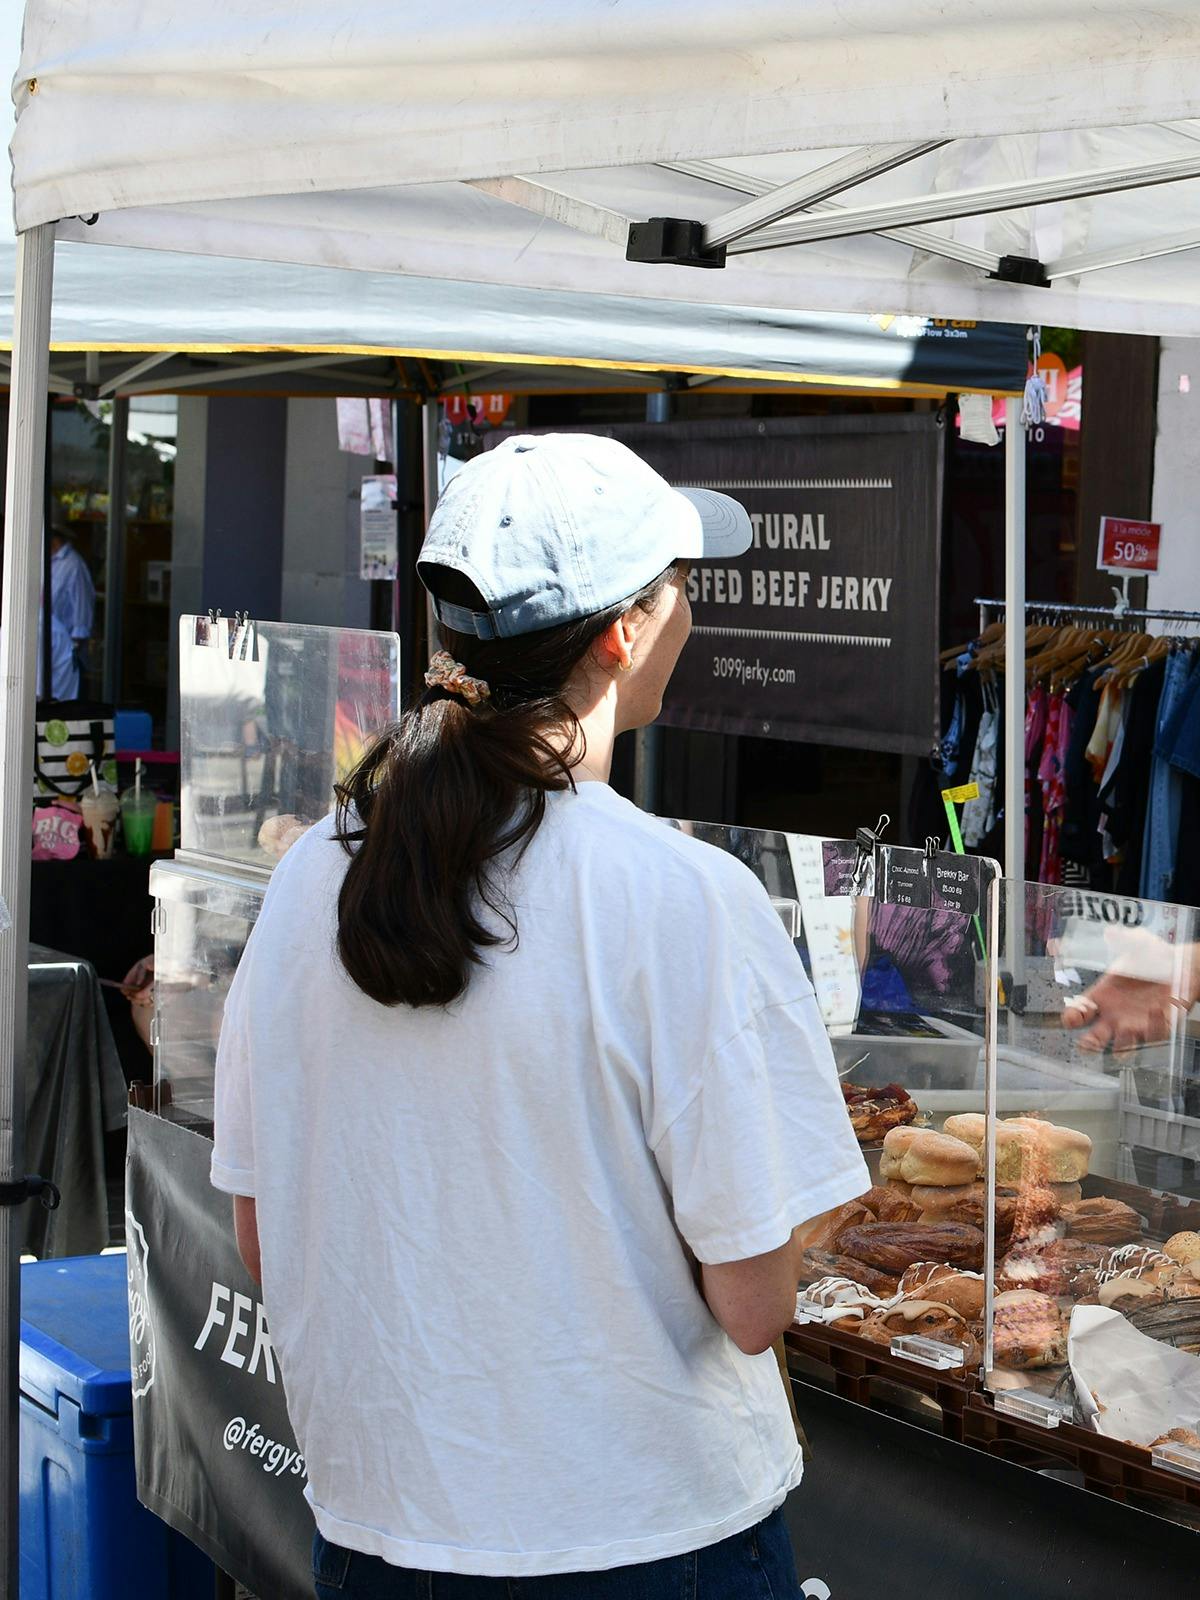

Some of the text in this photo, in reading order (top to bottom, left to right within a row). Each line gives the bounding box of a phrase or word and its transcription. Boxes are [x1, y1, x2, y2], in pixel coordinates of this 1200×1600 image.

[1113, 541, 1148, 561] 50%
[751, 569, 811, 608] BEEF
[816, 574, 892, 612] JERKY
[713, 656, 796, 687] 3099jerky.com
[936, 867, 969, 882] Brekky Bar
